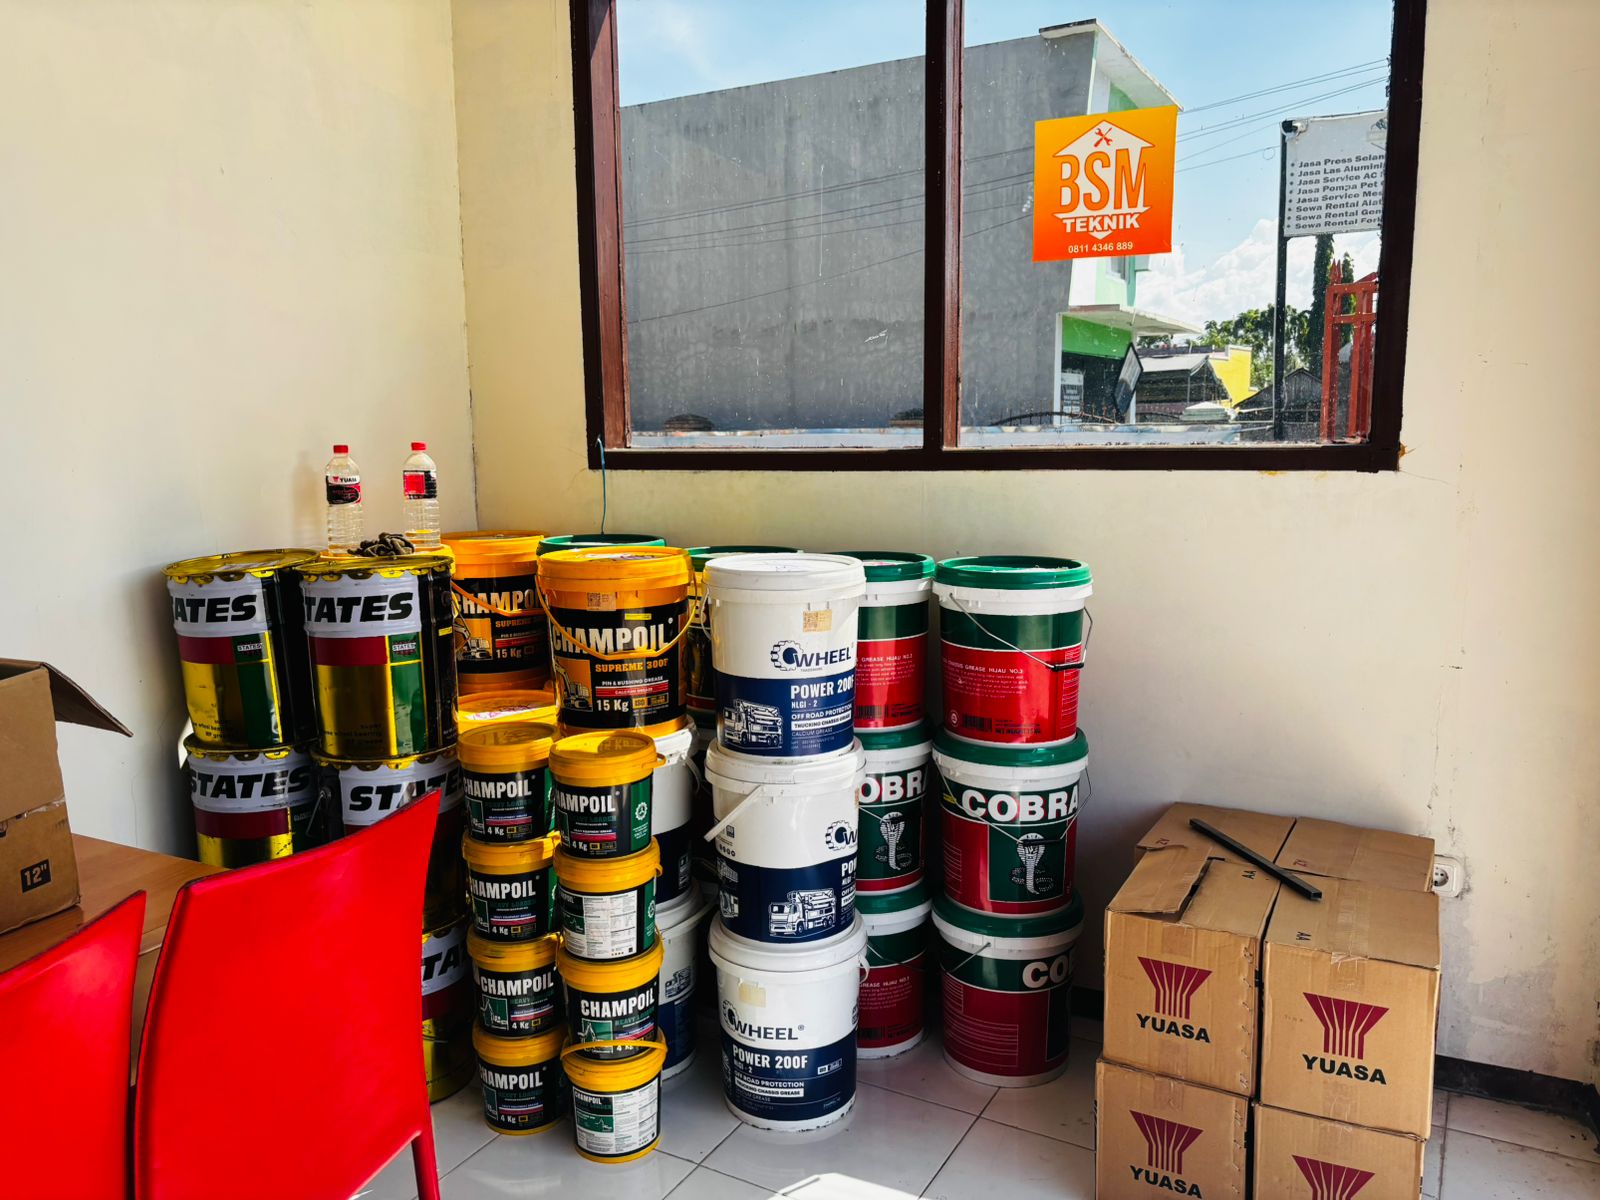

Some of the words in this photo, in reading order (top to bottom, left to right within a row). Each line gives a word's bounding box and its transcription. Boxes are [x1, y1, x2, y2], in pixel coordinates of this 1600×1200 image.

[1324, 158, 1352, 166] Press
[1060, 147, 1148, 214] BSM
[1363, 172, 1377, 180] AC
[1296, 204, 1322, 212] Sewa
[1326, 201, 1359, 210] Rental
[1062, 213, 1140, 233] TEKNIK
[1295, 221, 1321, 229] Sewa
[1324, 218, 1358, 227] Rental
[1296, 213, 1322, 221] Sewa
[1324, 210, 1358, 219] Rental
[1068, 243, 1088, 254] 0811
[1092, 242, 1114, 252] 4346
[1116, 241, 1134, 251] 889
[552, 623, 670, 654] CHAMPOIL
[496, 648, 508, 659] 15
[794, 646, 852, 668] WHEEL
[595, 662, 644, 673] SUPREME
[790, 684, 833, 700] POWER
[596, 700, 610, 712] 15
[614, 698, 630, 712] Kg
[464, 778, 532, 800] CHAMPOIL
[858, 769, 926, 804] OBR
[962, 784, 1078, 822] COBRA
[488, 826, 492, 834] 4
[494, 826, 504, 836] Kg
[578, 842, 588, 852] Kg
[24, 864, 48, 886] 12"
[499, 926, 509, 935] Kg
[480, 972, 554, 997] CHAMPOIL
[580, 992, 655, 1018] CHAMPOIL
[512, 1022, 518, 1030] 4
[519, 1022, 530, 1030] Kg
[733, 1020, 799, 1040] WHEEL
[1136, 1013, 1210, 1044] YUASA
[732, 1044, 770, 1069] POWER
[774, 1054, 808, 1070] 200F
[479, 1064, 543, 1091] CHAMPOIL
[1302, 1053, 1387, 1086] YUASA
[744, 1075, 760, 1086] ROAD
[760, 1079, 804, 1088] PROTECTION
[574, 1090, 602, 1105] CHAMPOIL
[500, 1114, 506, 1122] 4
[507, 1114, 516, 1124] Kg
[1129, 1164, 1202, 1200] YUASA
